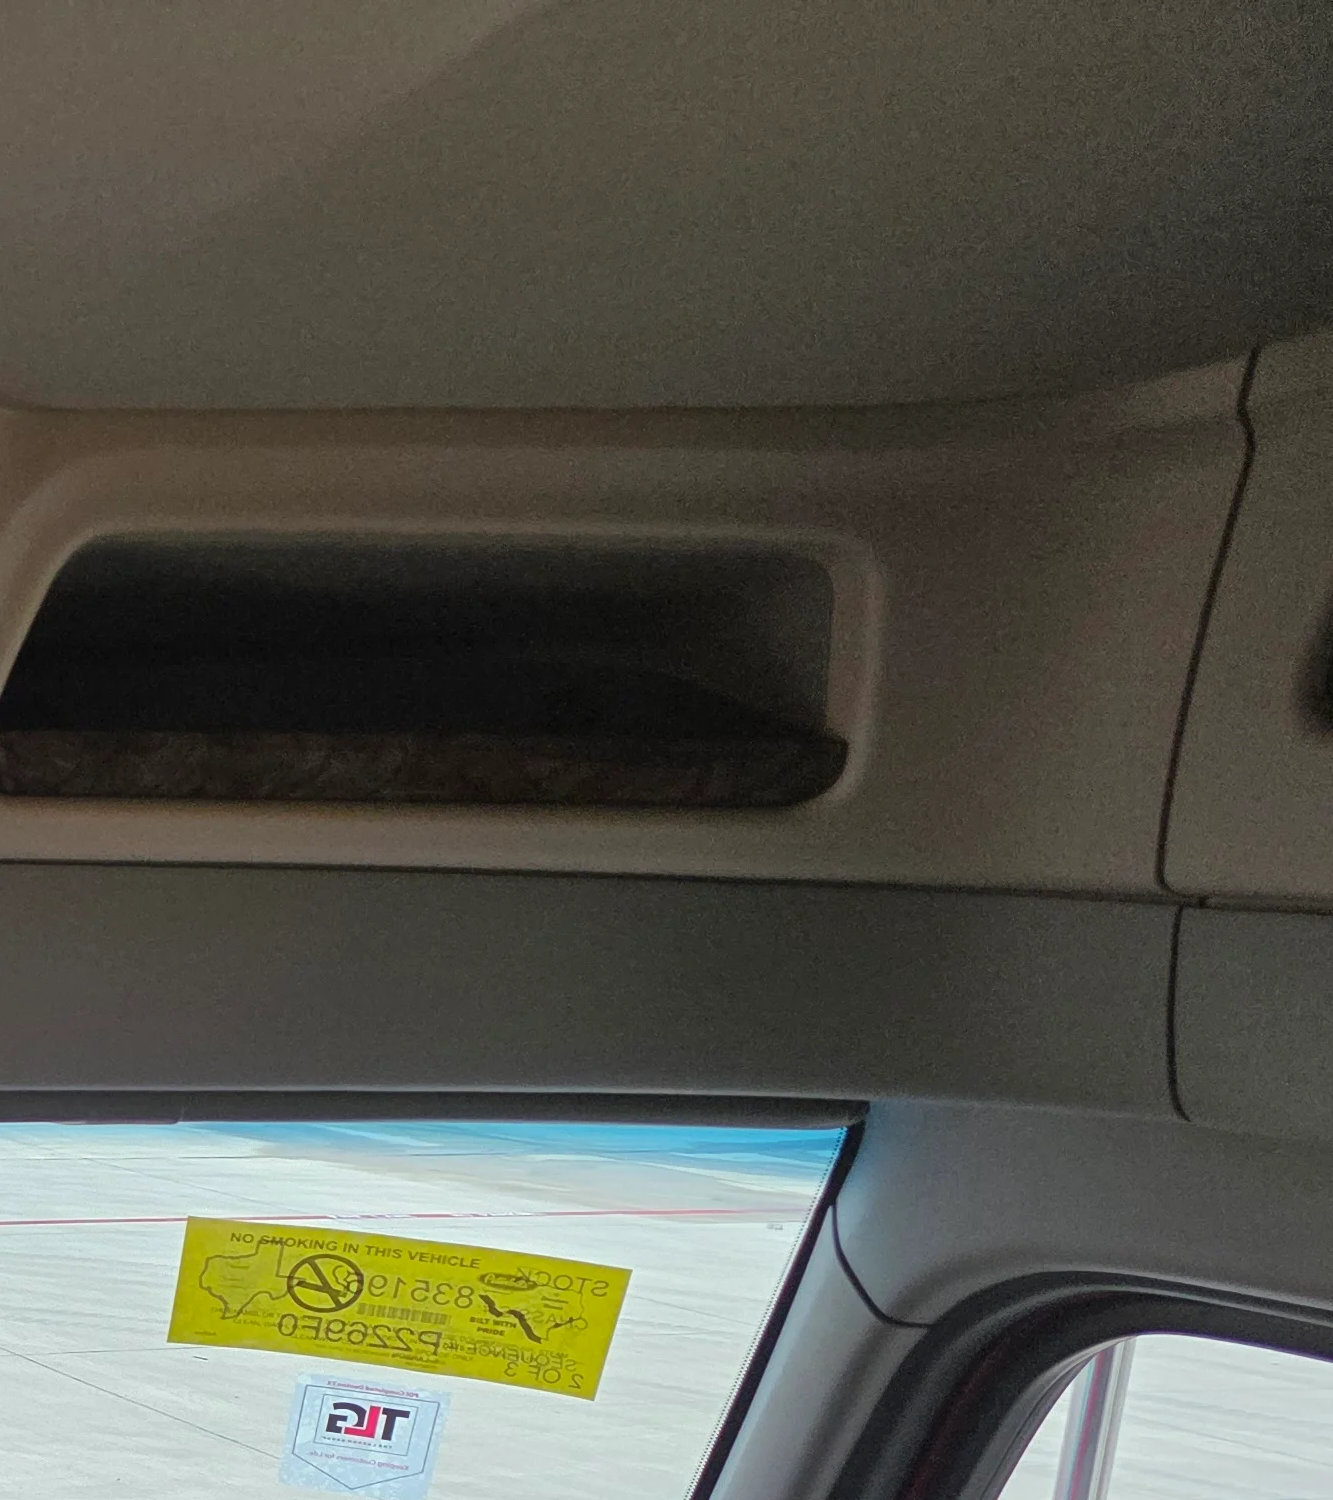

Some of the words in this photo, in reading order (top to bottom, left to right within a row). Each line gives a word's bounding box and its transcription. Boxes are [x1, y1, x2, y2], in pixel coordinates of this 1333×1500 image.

[230, 1232, 255, 1244] NO
[259, 1235, 338, 1252] SMOKING
[342, 1241, 359, 1254] IN
[365, 1245, 402, 1260] THIS
[408, 1250, 482, 1269] VEHICLE
